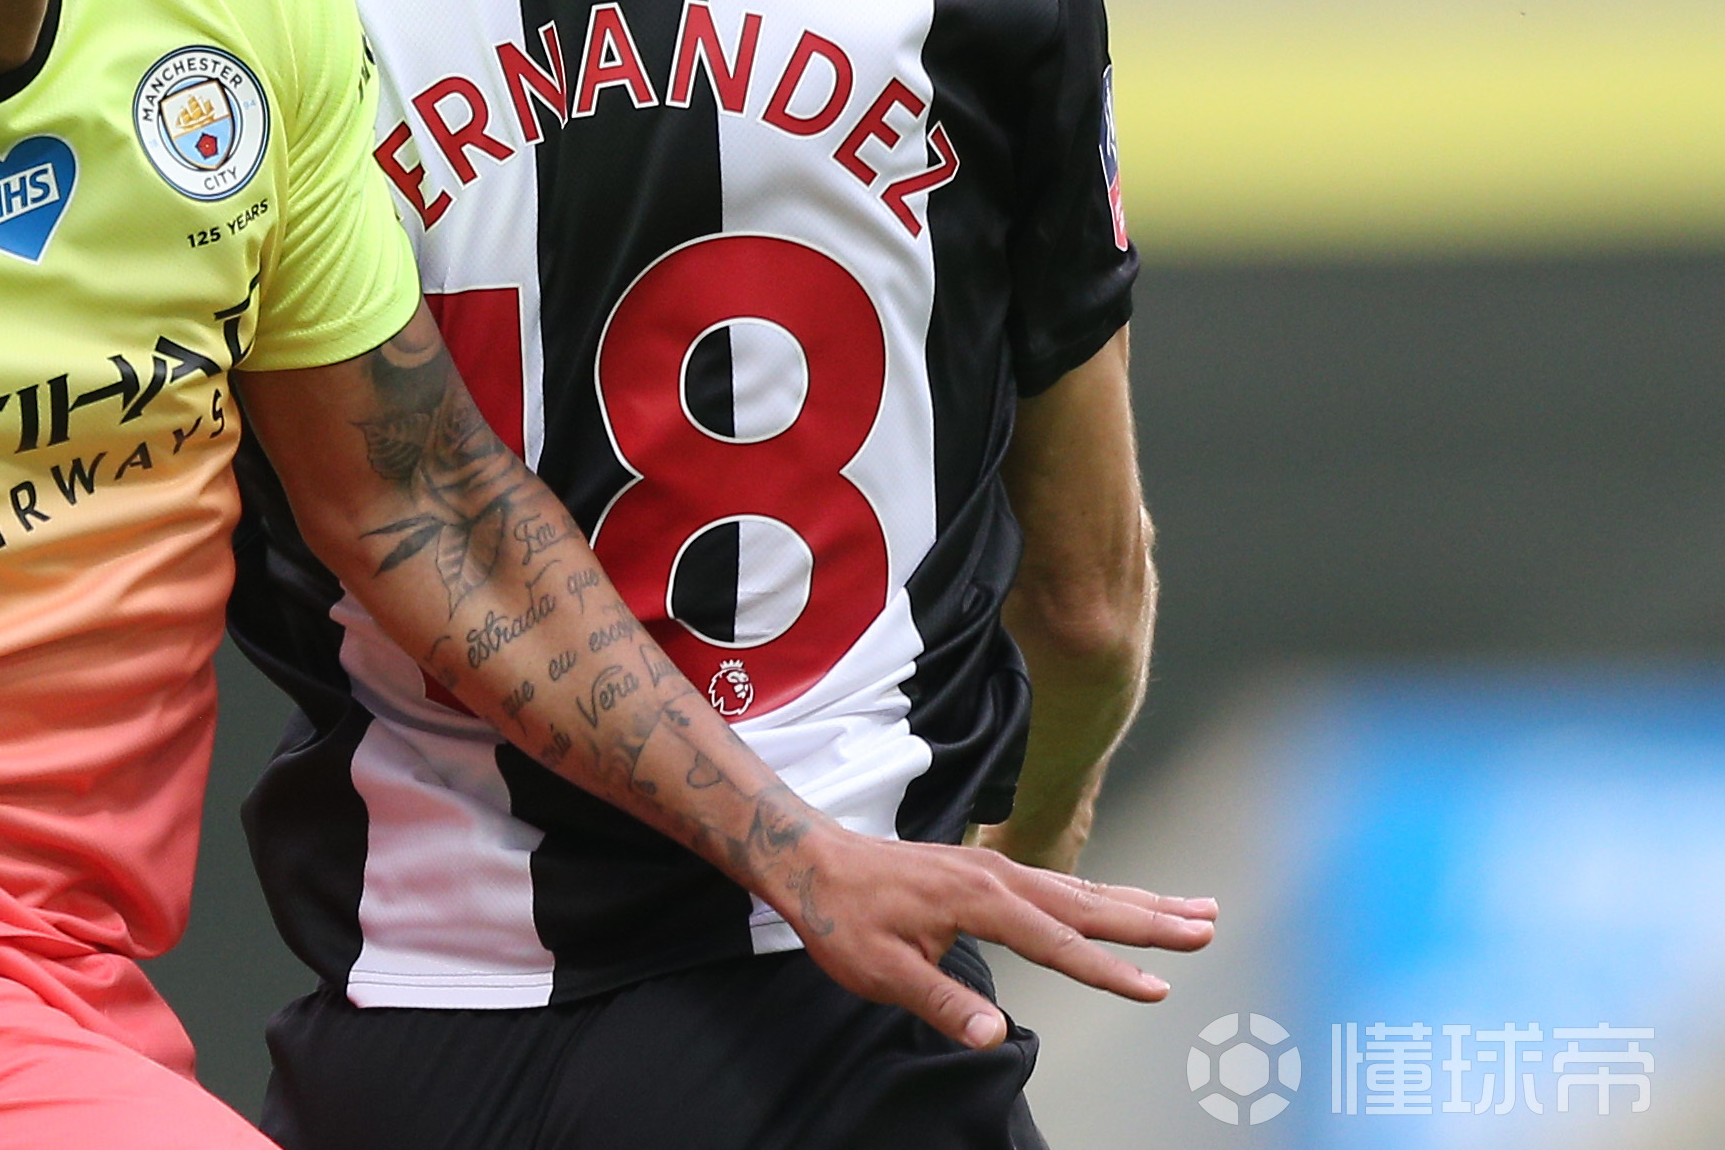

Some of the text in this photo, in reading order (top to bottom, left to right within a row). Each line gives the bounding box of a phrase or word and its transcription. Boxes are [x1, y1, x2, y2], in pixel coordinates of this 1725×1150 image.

[142, 56, 244, 122] MANCHESTER
[203, 165, 239, 191] CITY
[187, 198, 269, 248] 125 YEARS
[466, 559, 562, 669] estrada
[576, 664, 640, 730] Vera
